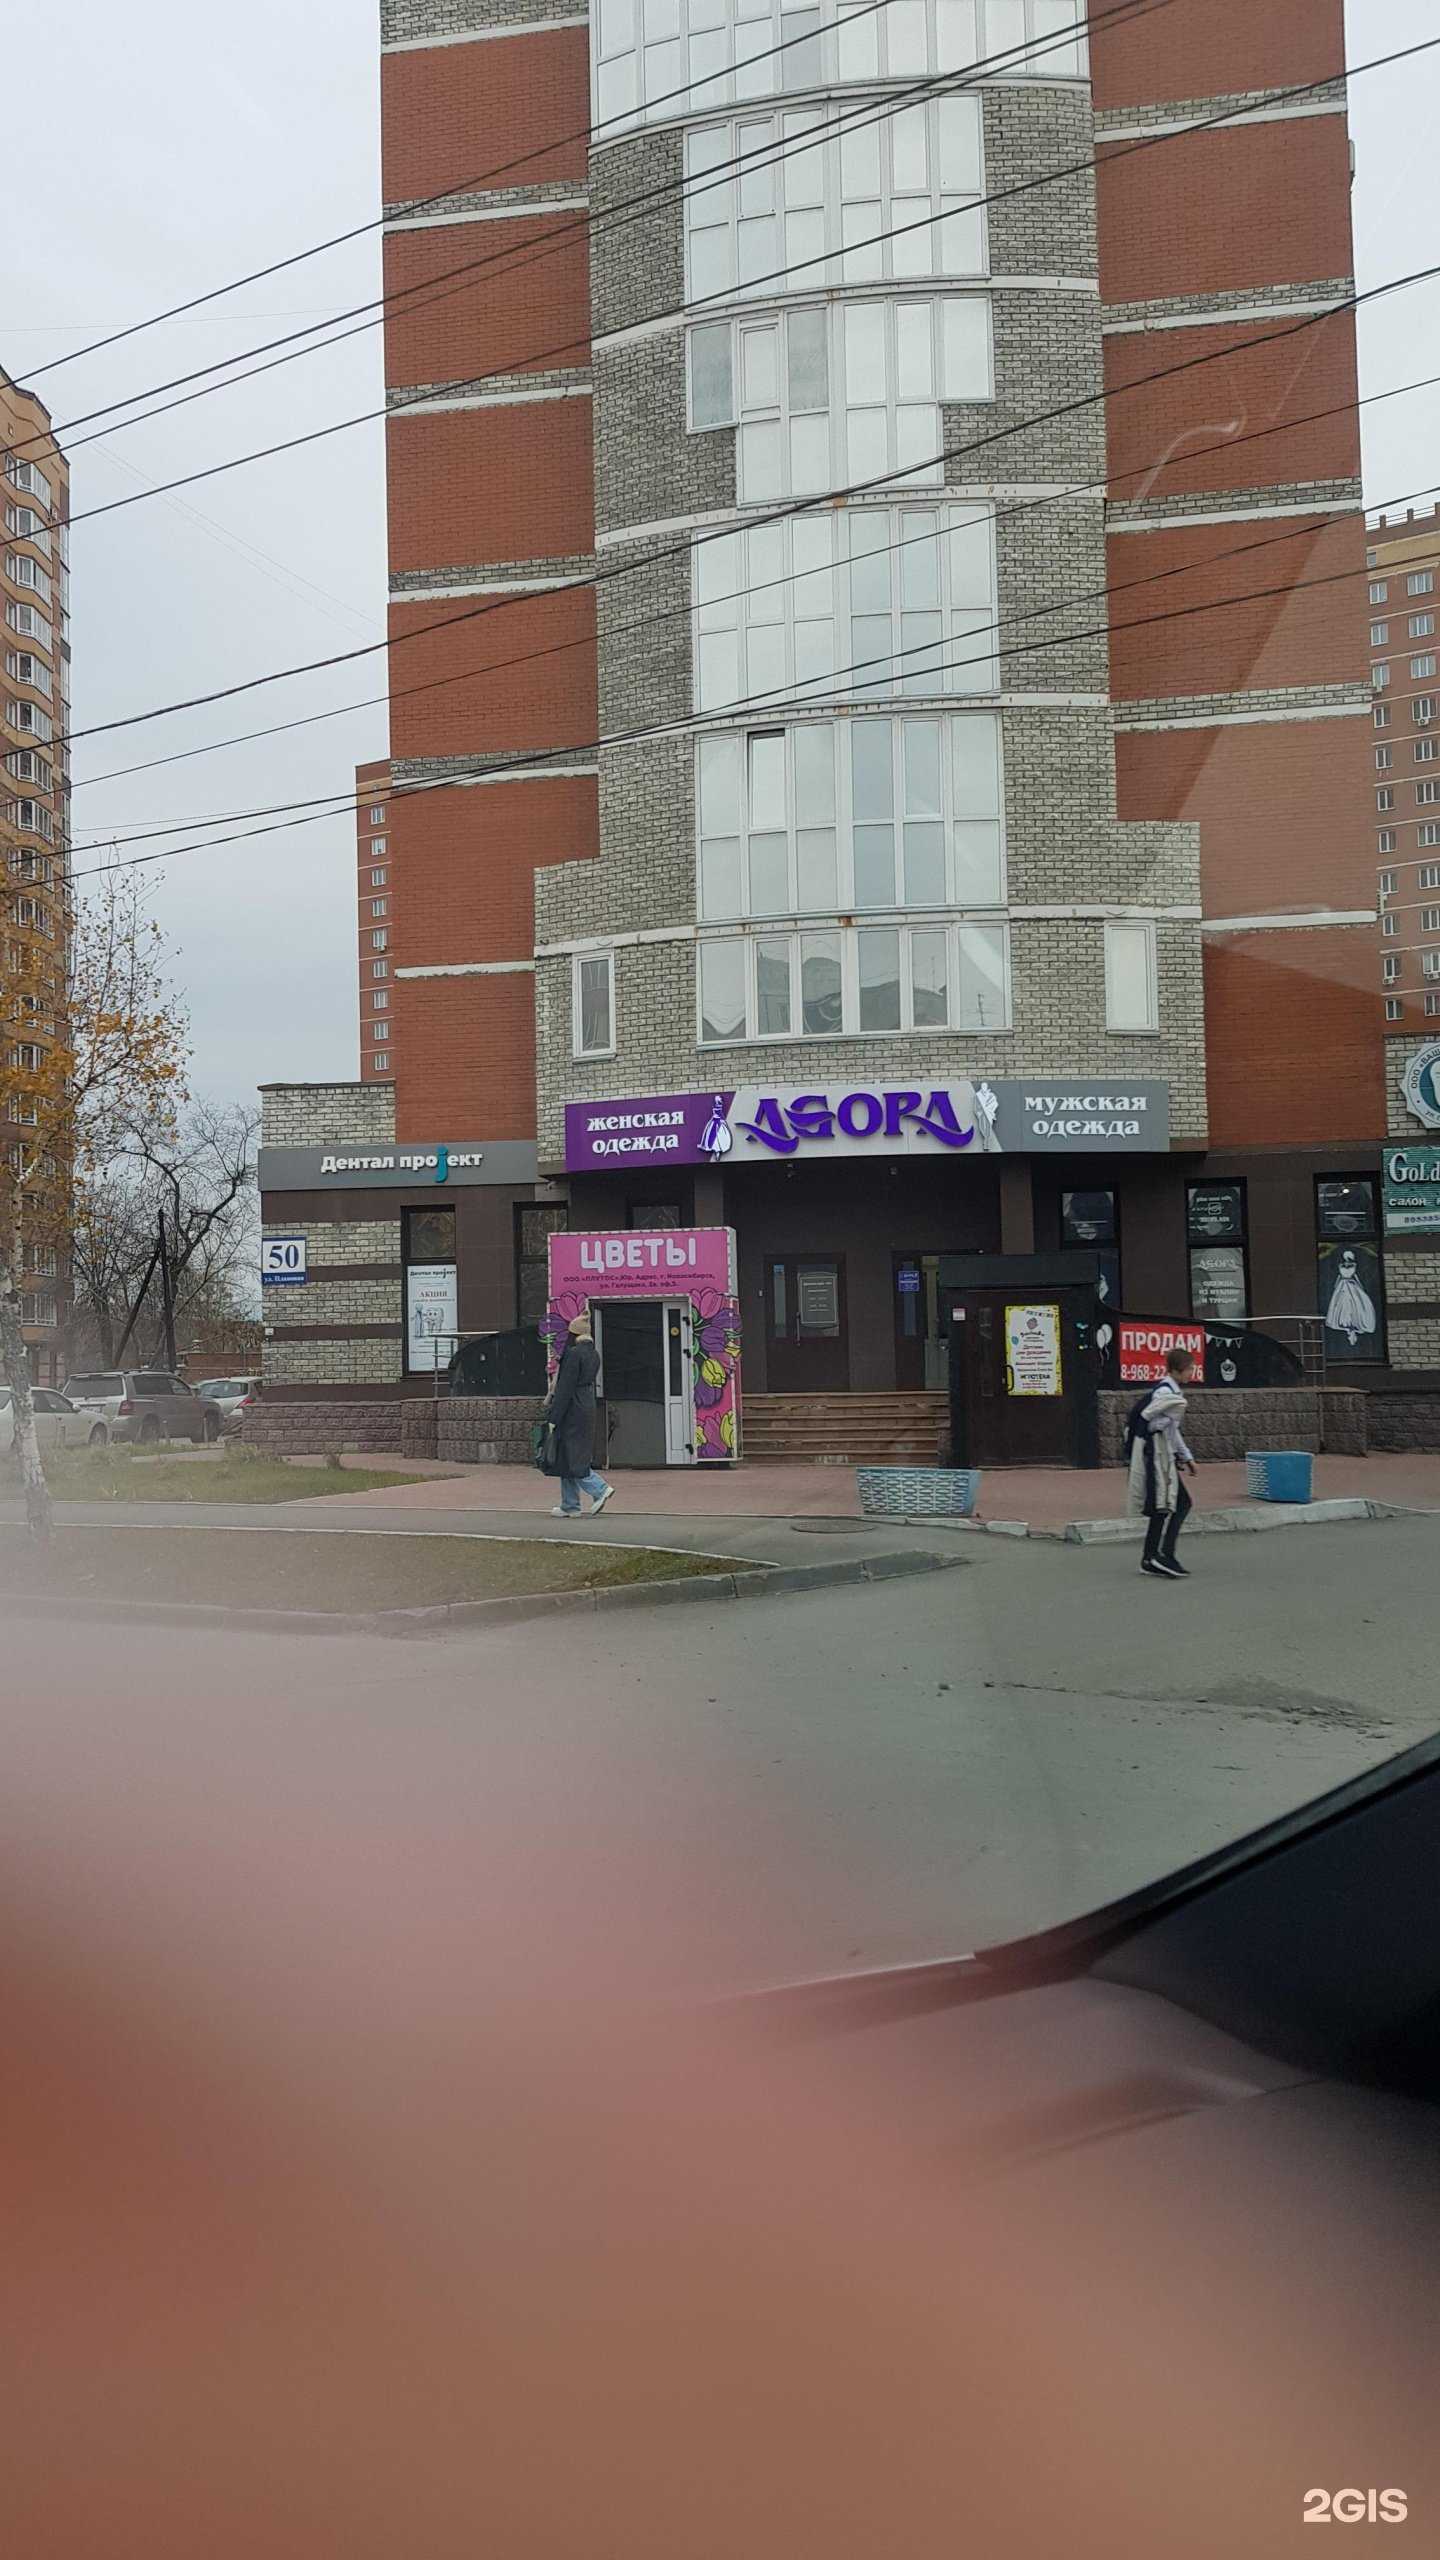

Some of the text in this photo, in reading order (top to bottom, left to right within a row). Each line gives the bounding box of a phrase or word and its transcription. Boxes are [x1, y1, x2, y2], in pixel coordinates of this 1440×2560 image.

[1025, 1096, 1147, 1116] мужская
[586, 1110, 684, 1132] женская
[1032, 1119, 1141, 1139] одежда
[592, 1133, 680, 1157] одежда
[321, 1155, 394, 1173] Дентал
[268, 1244, 300, 1270] 50
[580, 1237, 697, 1274] ЦВЕТЫ
[1121, 1331, 1202, 1355] ПРОДАМ
